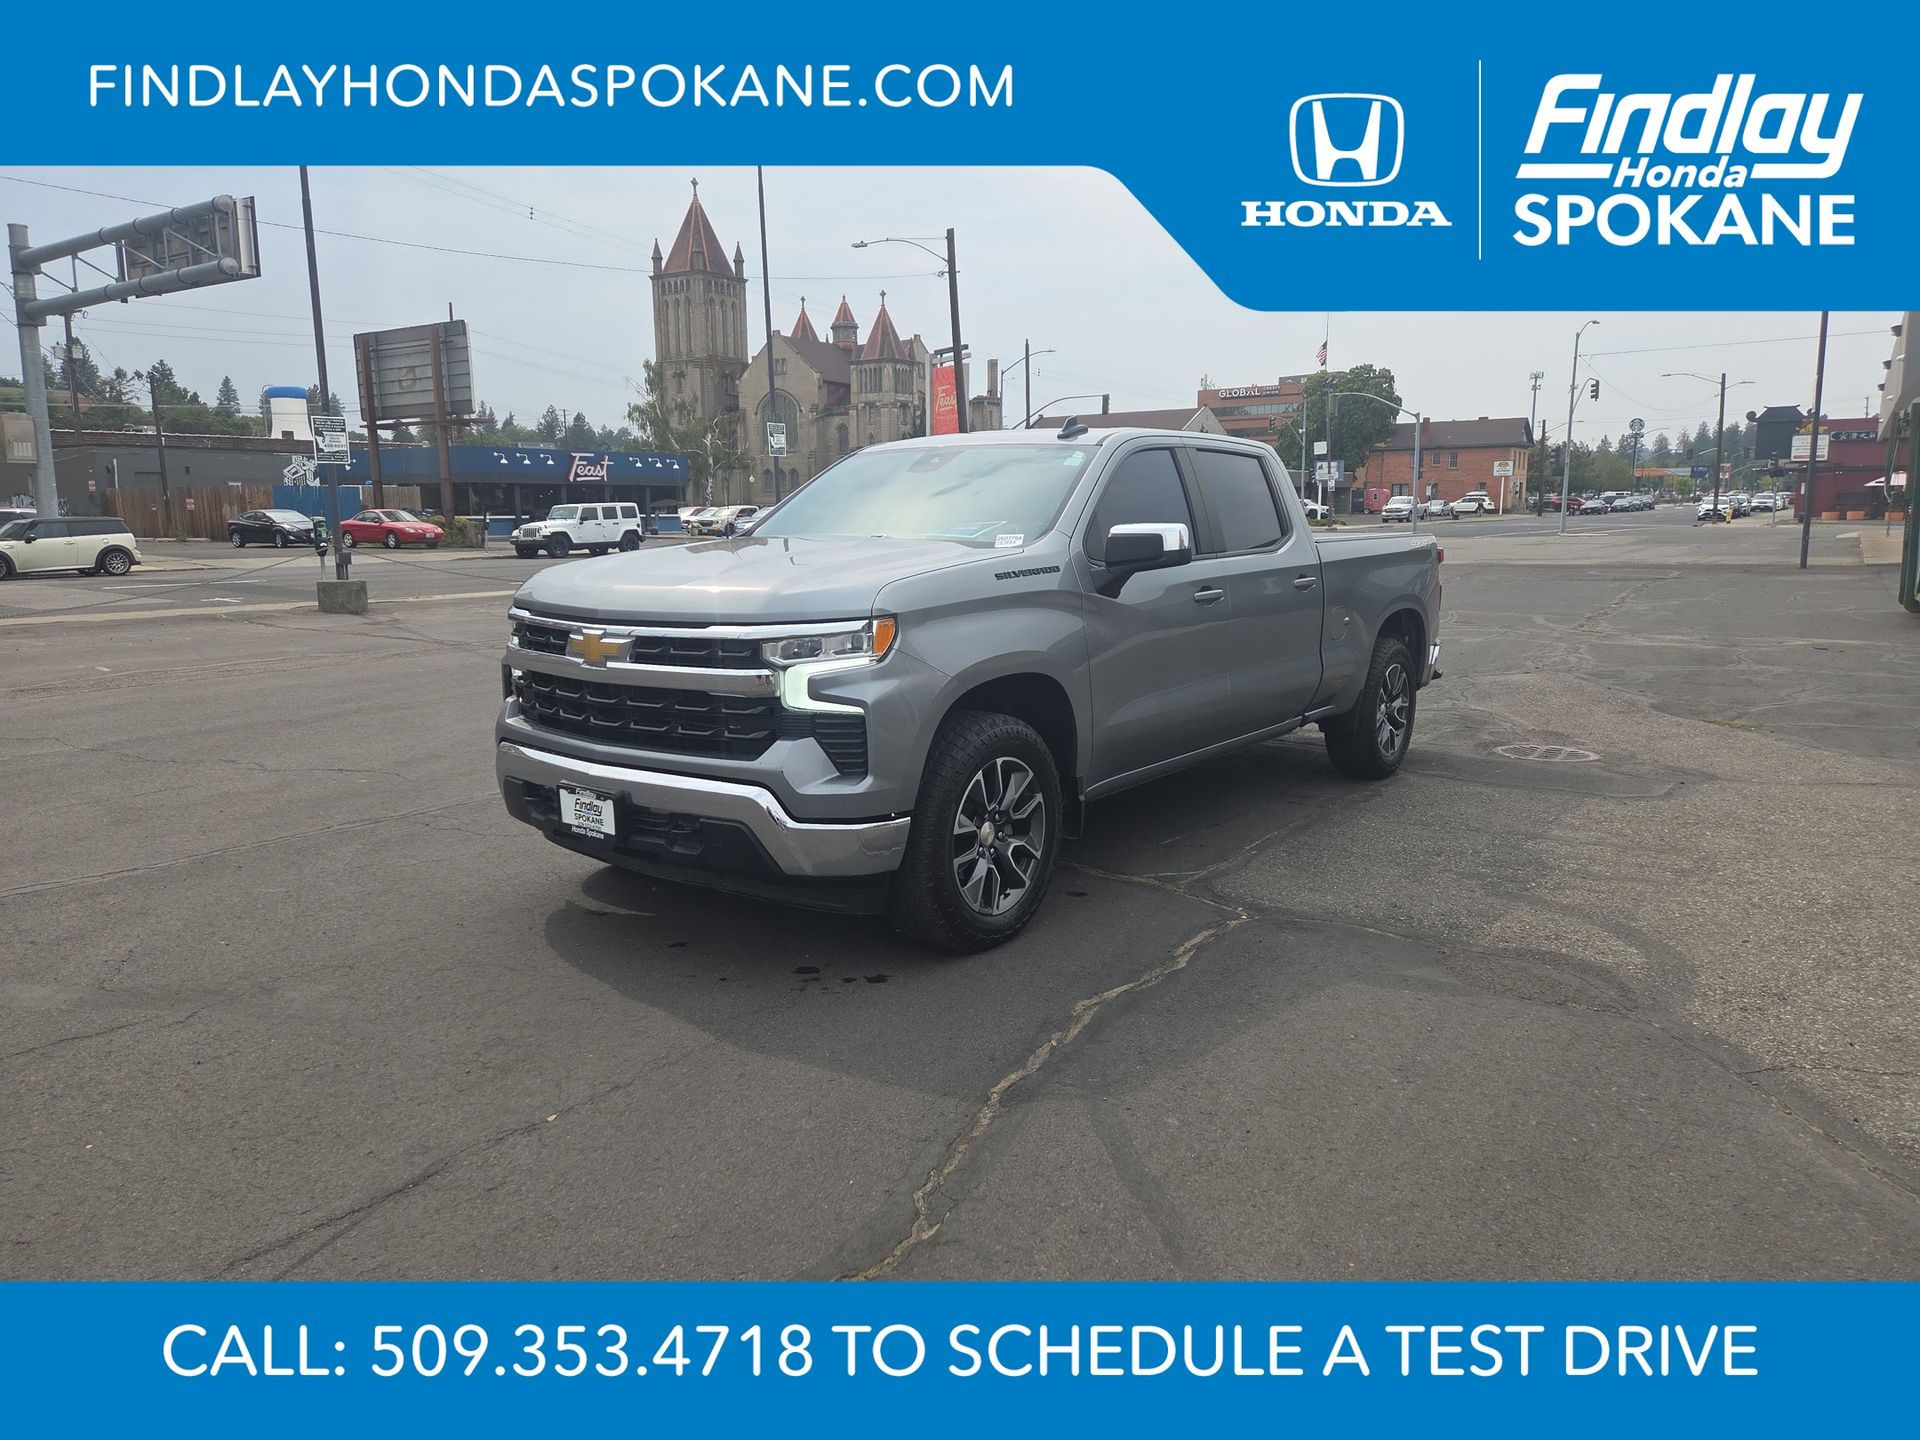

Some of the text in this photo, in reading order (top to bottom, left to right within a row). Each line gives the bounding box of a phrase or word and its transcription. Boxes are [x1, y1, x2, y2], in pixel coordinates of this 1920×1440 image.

[1218, 387, 1261, 398] GLOBAL
[568, 452, 614, 482] Feast
[994, 565, 1061, 580] SILVERADO
[574, 798, 603, 817] Findlay
[574, 812, 605, 827] SPOKANE
[571, 825, 586, 835] Honda
[586, 828, 605, 840] Spokane
